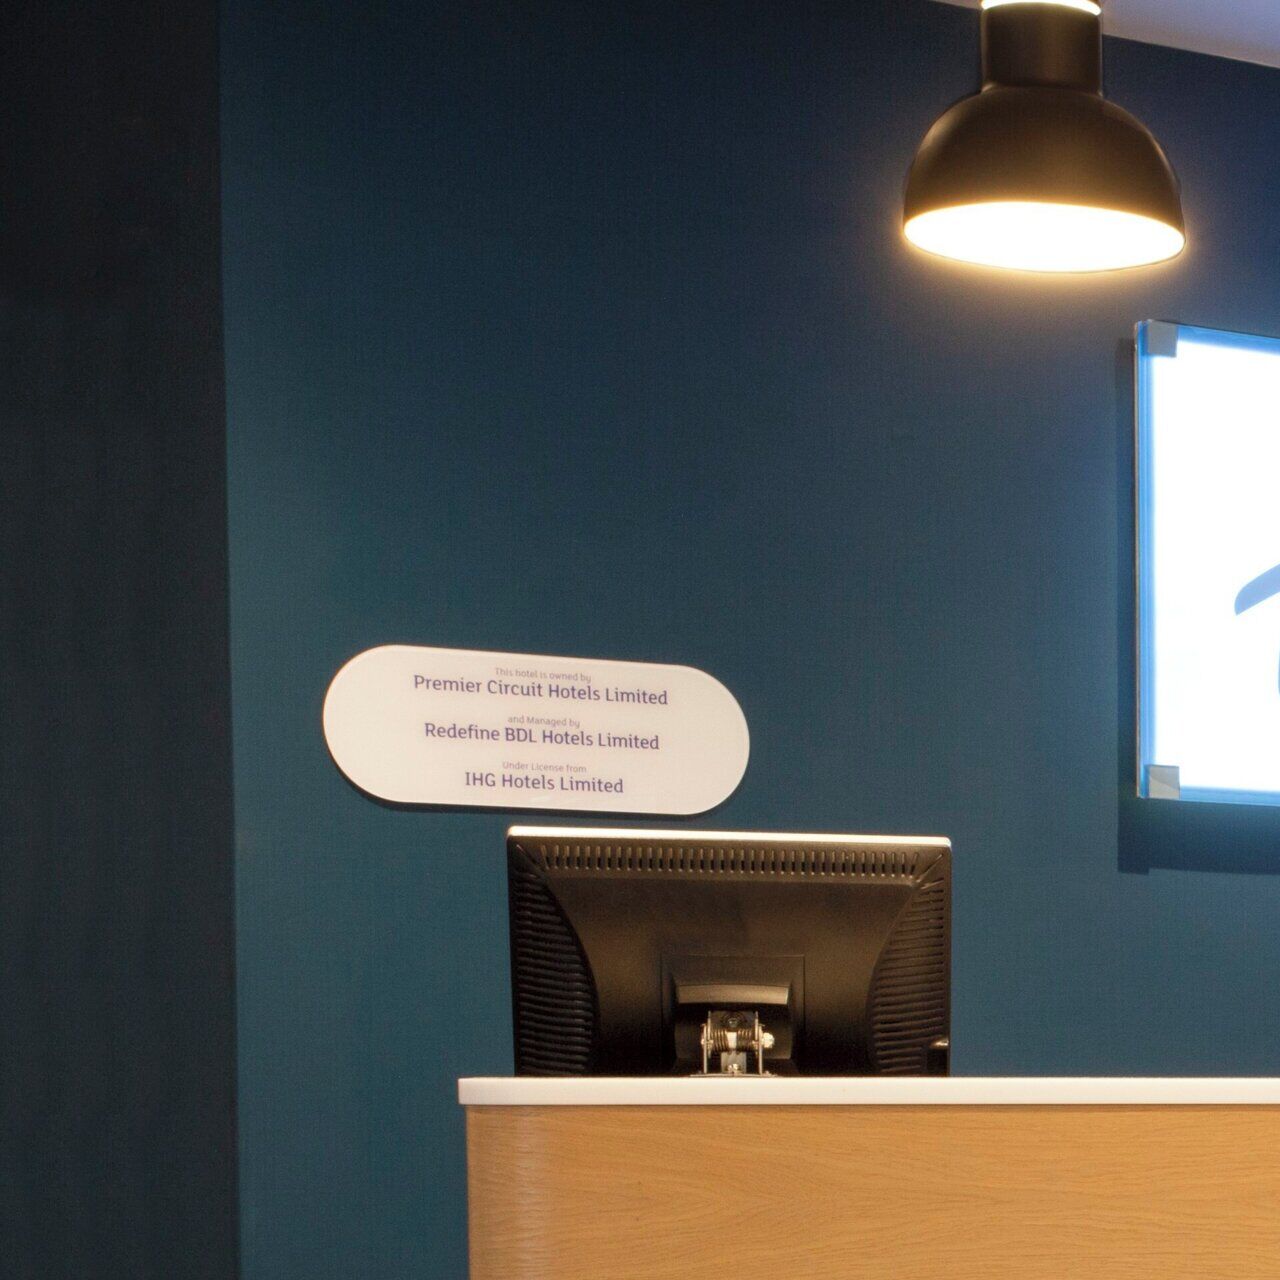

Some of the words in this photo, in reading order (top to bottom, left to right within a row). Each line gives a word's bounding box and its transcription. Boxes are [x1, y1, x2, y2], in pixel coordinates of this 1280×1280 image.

[495, 667, 513, 677] This
[515, 668, 538, 678] hotel
[549, 672, 579, 681] owned
[580, 672, 592, 684] by
[414, 674, 483, 693] Premier
[487, 679, 543, 697] Circuit
[548, 683, 601, 701] Hotels
[605, 687, 668, 705] Limited
[507, 714, 525, 724] and
[526, 716, 567, 727] Managed
[569, 718, 581, 729] by
[424, 722, 500, 741] Redefine
[504, 726, 537, 743] BDL
[542, 729, 594, 746] Hotels
[598, 733, 660, 750] Limited
[502, 761, 529, 770] Under
[566, 764, 587, 773] from
[465, 772, 496, 787] IHG
[501, 774, 555, 790] Hotels
[560, 776, 624, 793] Limited
